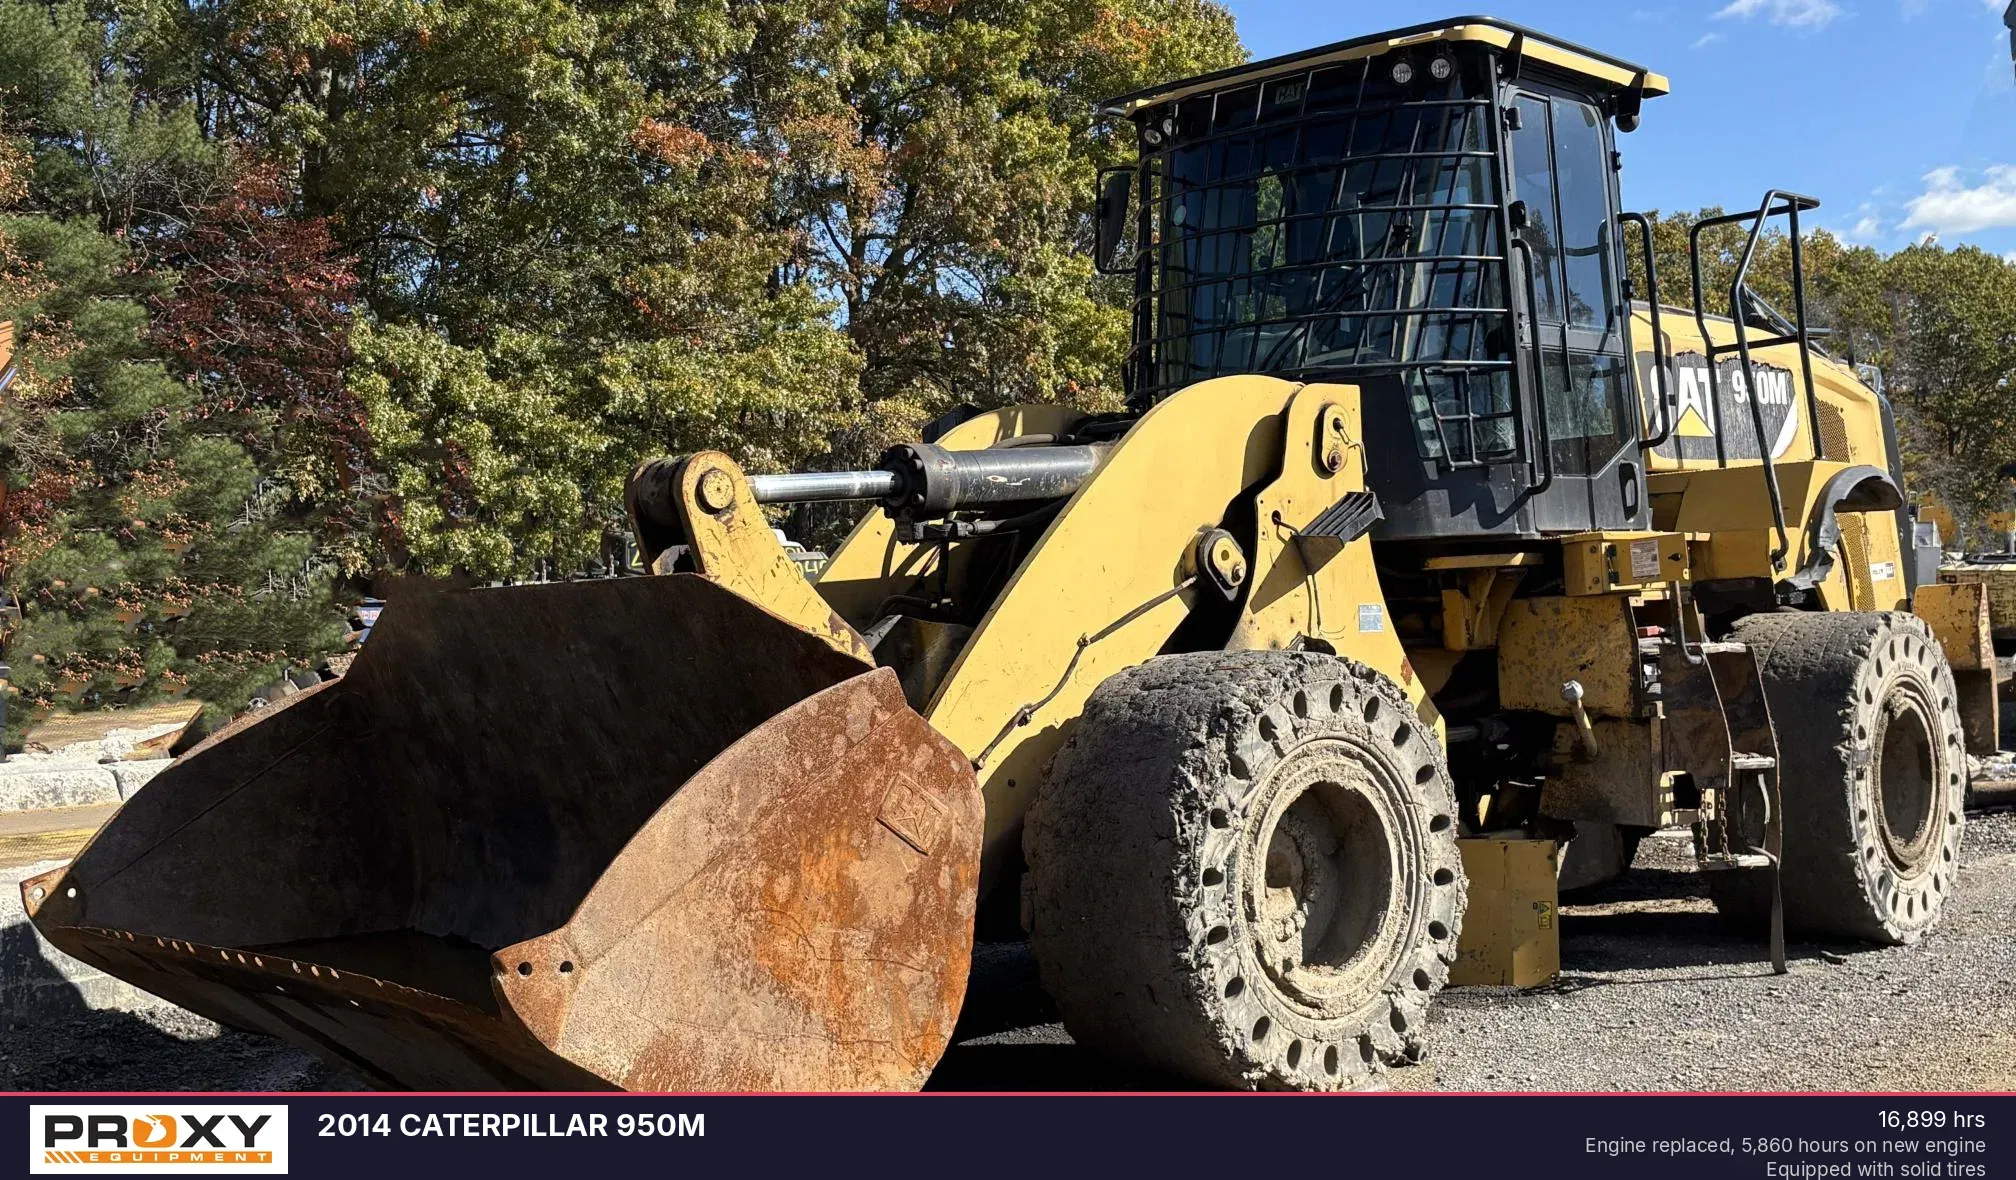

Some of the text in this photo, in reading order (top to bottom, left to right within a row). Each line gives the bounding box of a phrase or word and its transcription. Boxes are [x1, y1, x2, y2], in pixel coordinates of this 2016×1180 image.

[1275, 83, 1304, 105] CAT
[1650, 365, 1787, 436] CAT 90M
